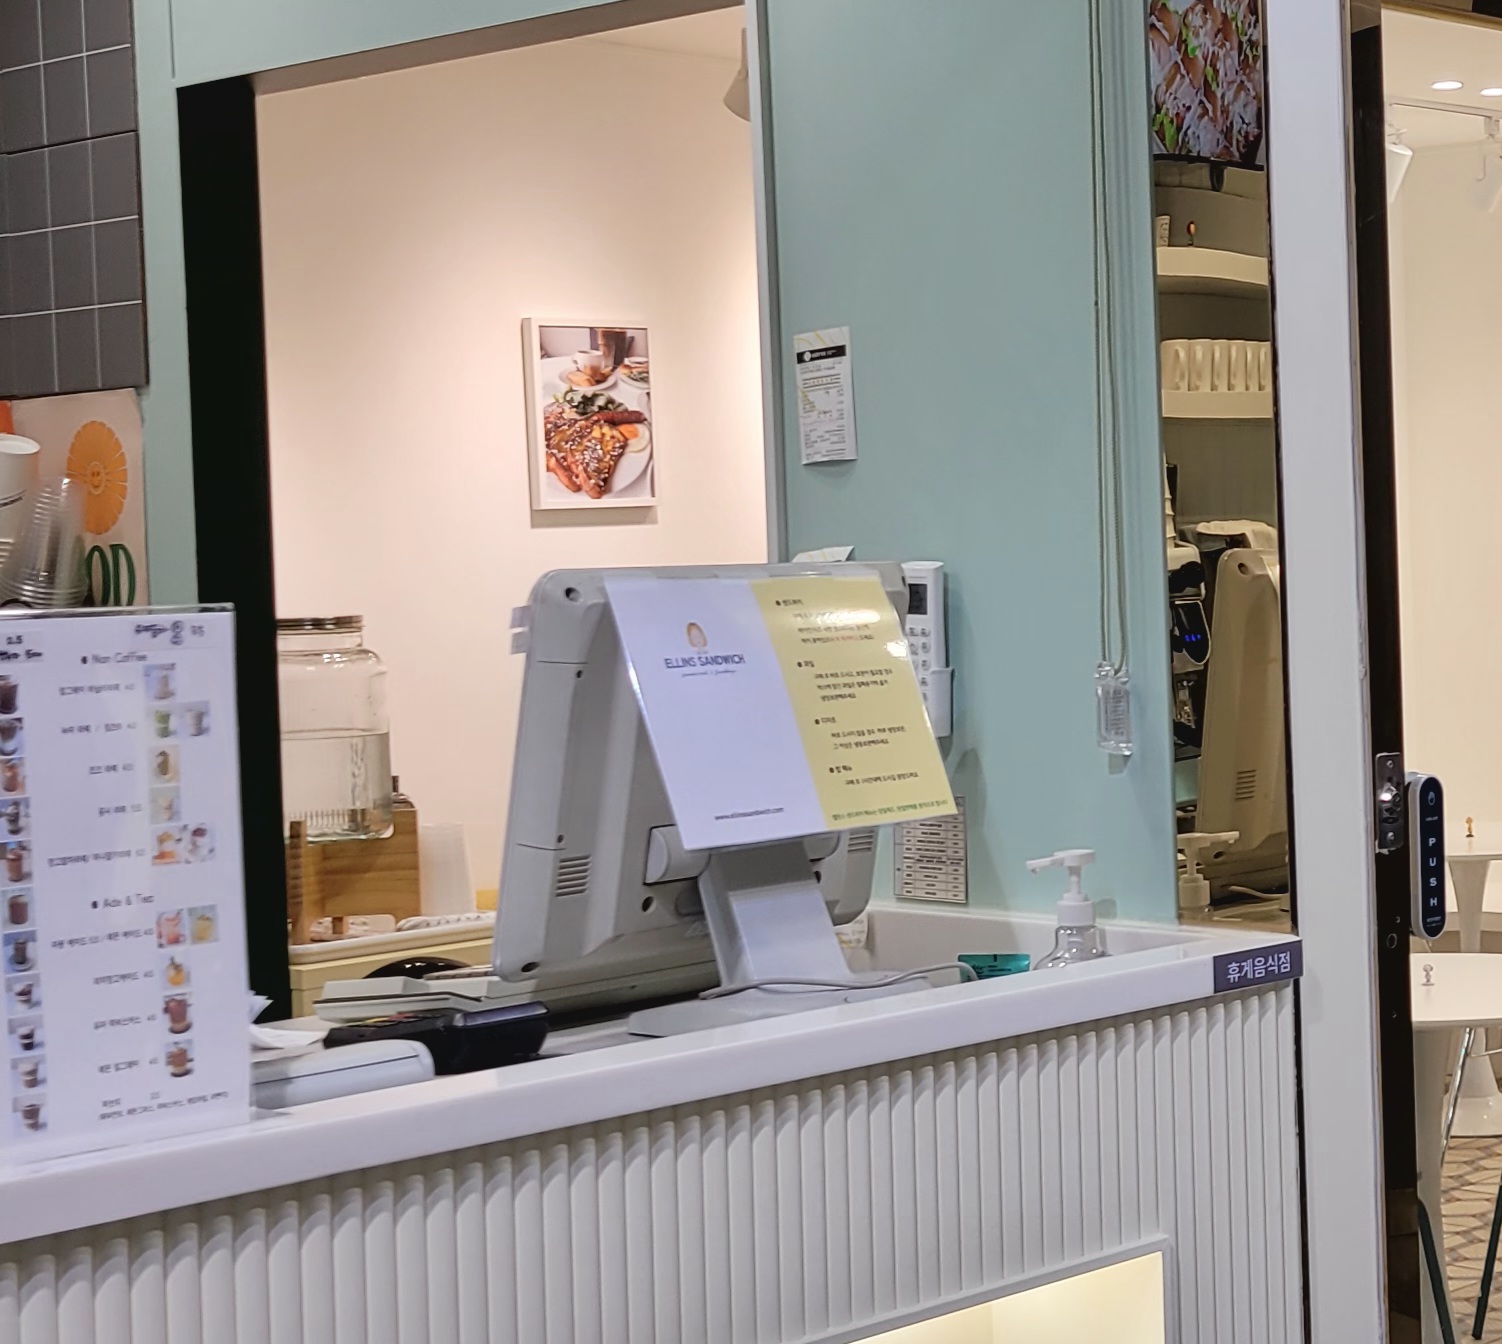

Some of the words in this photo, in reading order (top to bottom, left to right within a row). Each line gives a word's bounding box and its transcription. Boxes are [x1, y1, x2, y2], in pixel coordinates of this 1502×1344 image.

[664, 657, 697, 669] ELLINS
[699, 654, 746, 667] SANDWICH
[1428, 837, 1438, 907] PUSH
[1226, 951, 1291, 983] 휴게음식점
